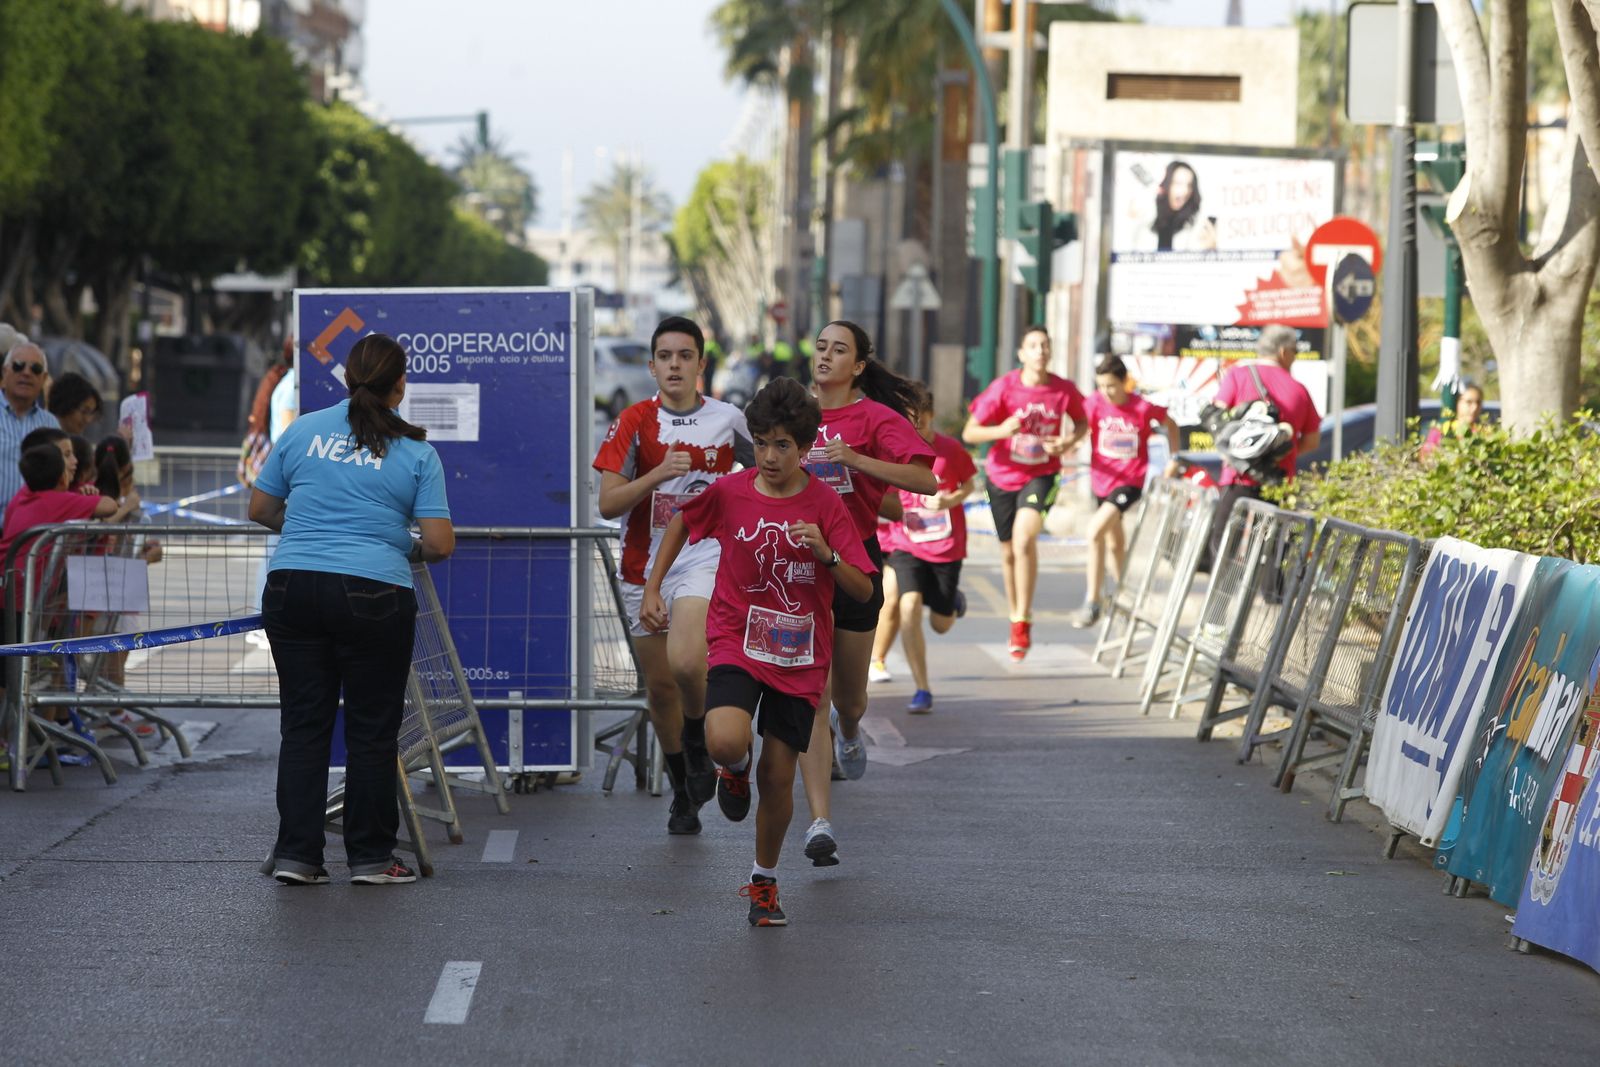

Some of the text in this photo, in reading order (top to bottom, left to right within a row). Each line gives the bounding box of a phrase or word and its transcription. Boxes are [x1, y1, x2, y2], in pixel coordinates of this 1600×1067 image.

[396, 328, 565, 353] COOPERACIÓN
[500, 354, 521, 364] ocio
[523, 355, 529, 365] y
[531, 354, 565, 363] cultura
[672, 418, 698, 427] BLK
